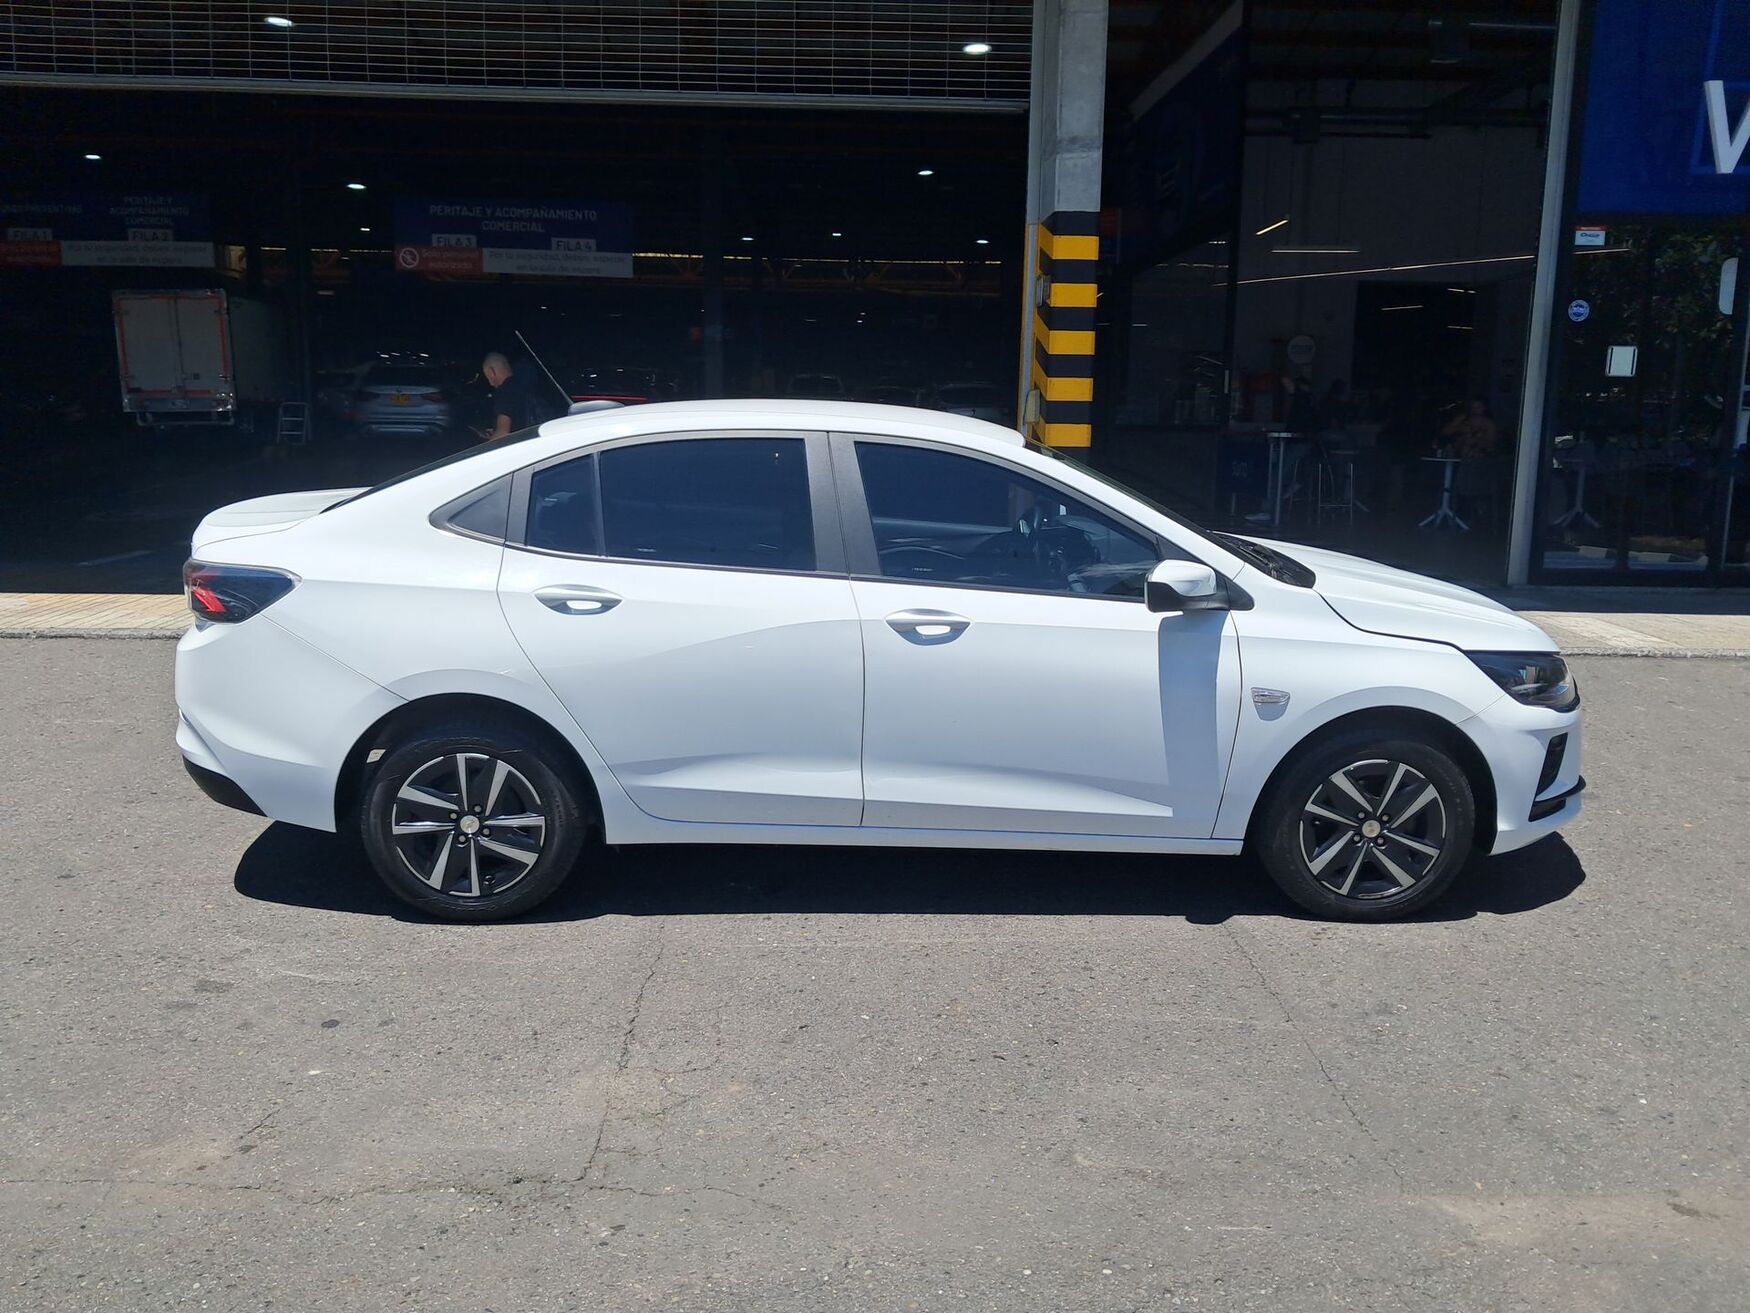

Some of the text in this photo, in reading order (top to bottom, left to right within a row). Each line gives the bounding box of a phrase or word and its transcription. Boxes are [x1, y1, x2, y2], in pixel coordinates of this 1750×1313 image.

[429, 204, 598, 222] PERITAJE Y ACOMPAÑAMIENTO
[481, 220, 546, 232] COMERCIAL
[133, 230, 159, 241] FILA
[436, 236, 473, 247] FILA 3
[556, 240, 592, 251] FILA 4
